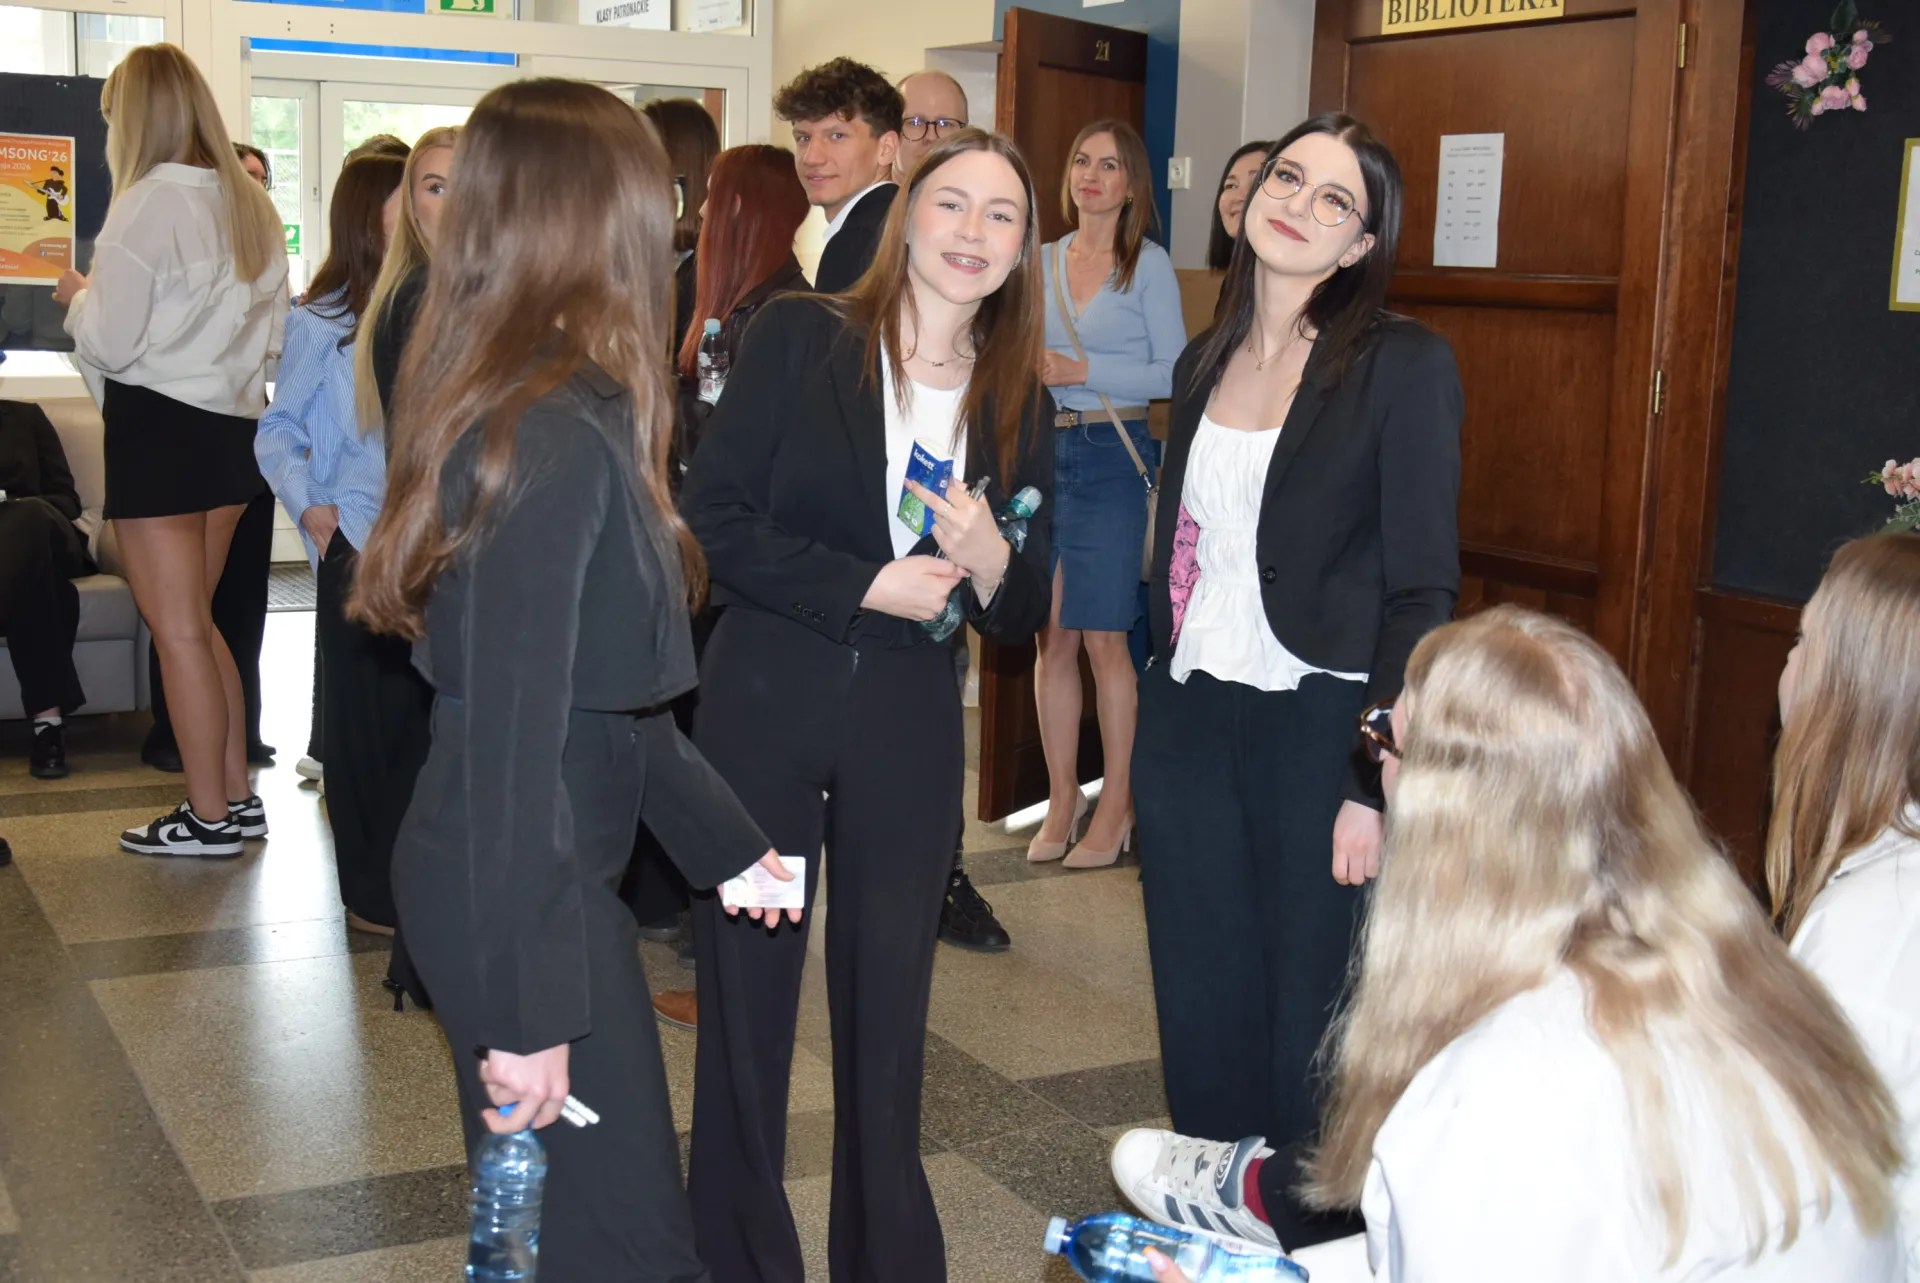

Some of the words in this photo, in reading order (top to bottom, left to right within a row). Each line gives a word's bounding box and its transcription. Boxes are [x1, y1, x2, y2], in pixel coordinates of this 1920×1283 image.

[596, 7, 612, 24] KLASY
[613, 0, 649, 20] PATRONACKIE
[1386, 0, 1559, 25] BIBLIOT
[1095, 39, 1110, 61] 21
